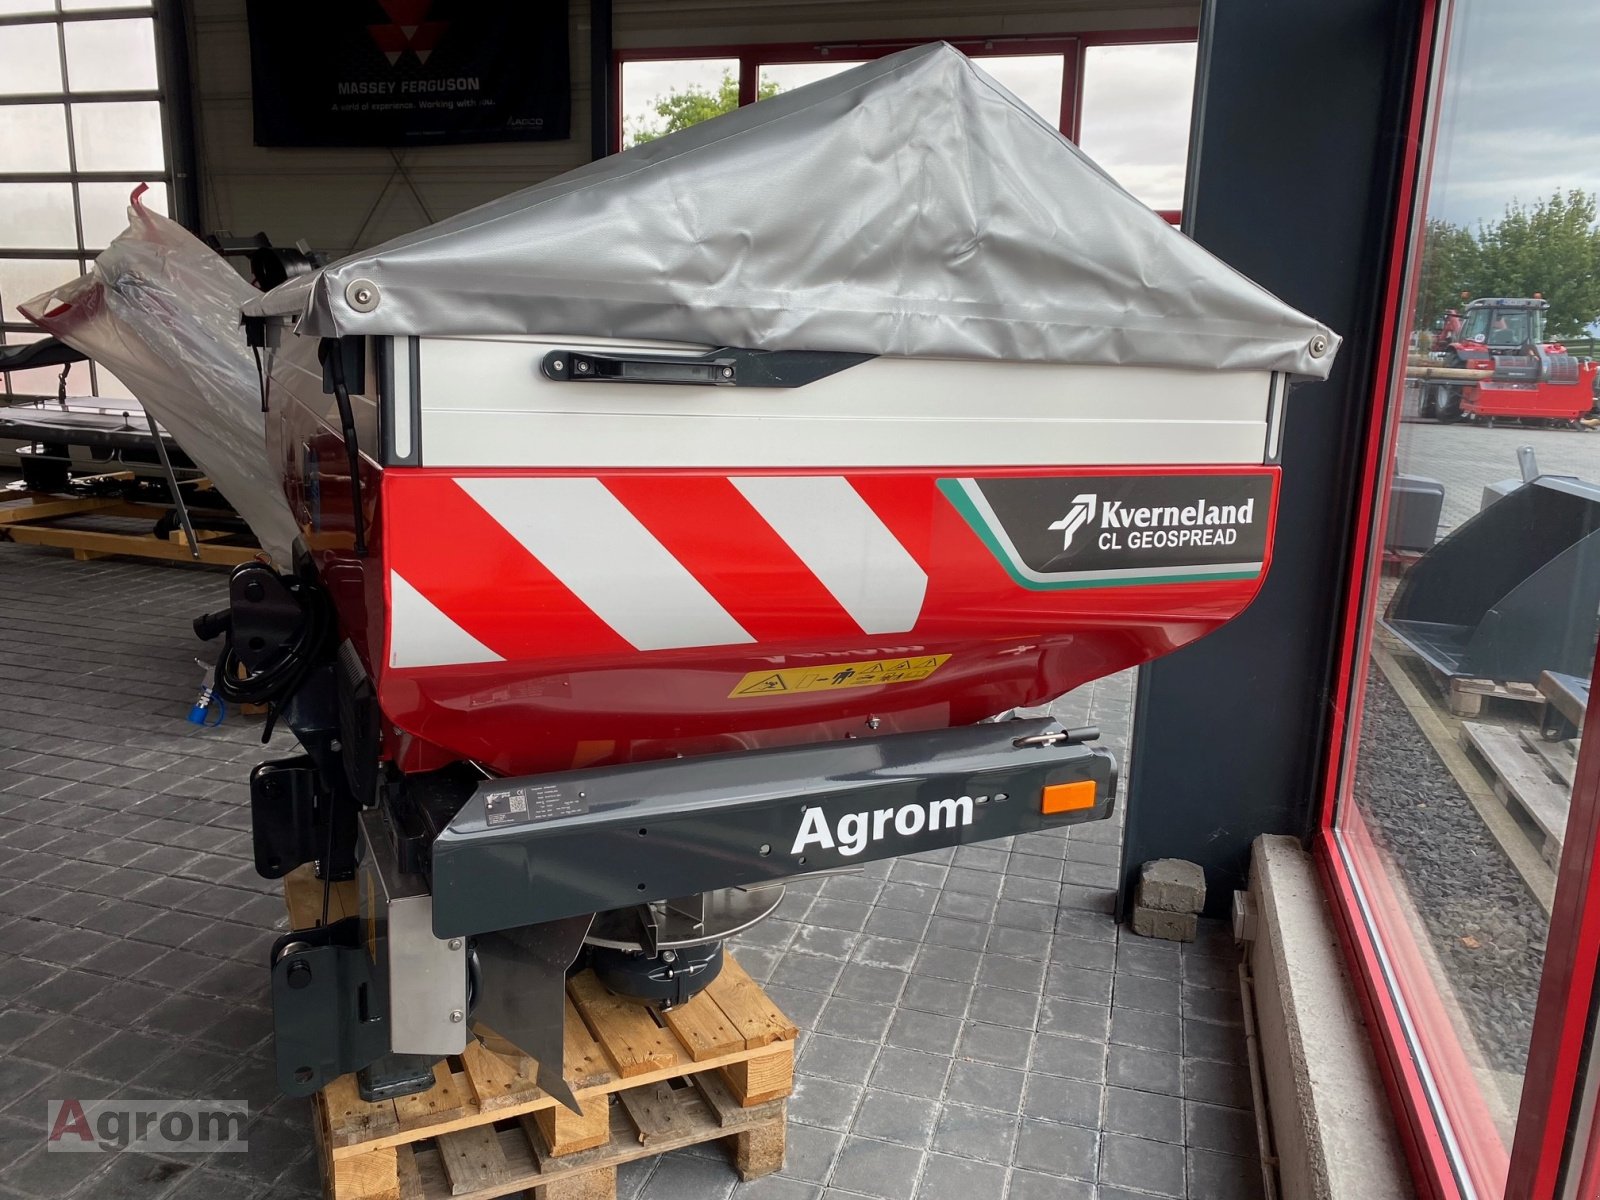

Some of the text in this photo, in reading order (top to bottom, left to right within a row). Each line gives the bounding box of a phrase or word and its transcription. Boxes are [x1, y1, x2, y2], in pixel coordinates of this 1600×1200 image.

[338, 77, 480, 95] MASSEY FERGUSON
[361, 102, 370, 111] of
[418, 99, 454, 111] Working
[456, 98, 477, 108] with
[1100, 498, 1254, 528] Kverneland
[1098, 528, 1237, 550] CL GEOSPREAD
[790, 796, 974, 857] Agrom
